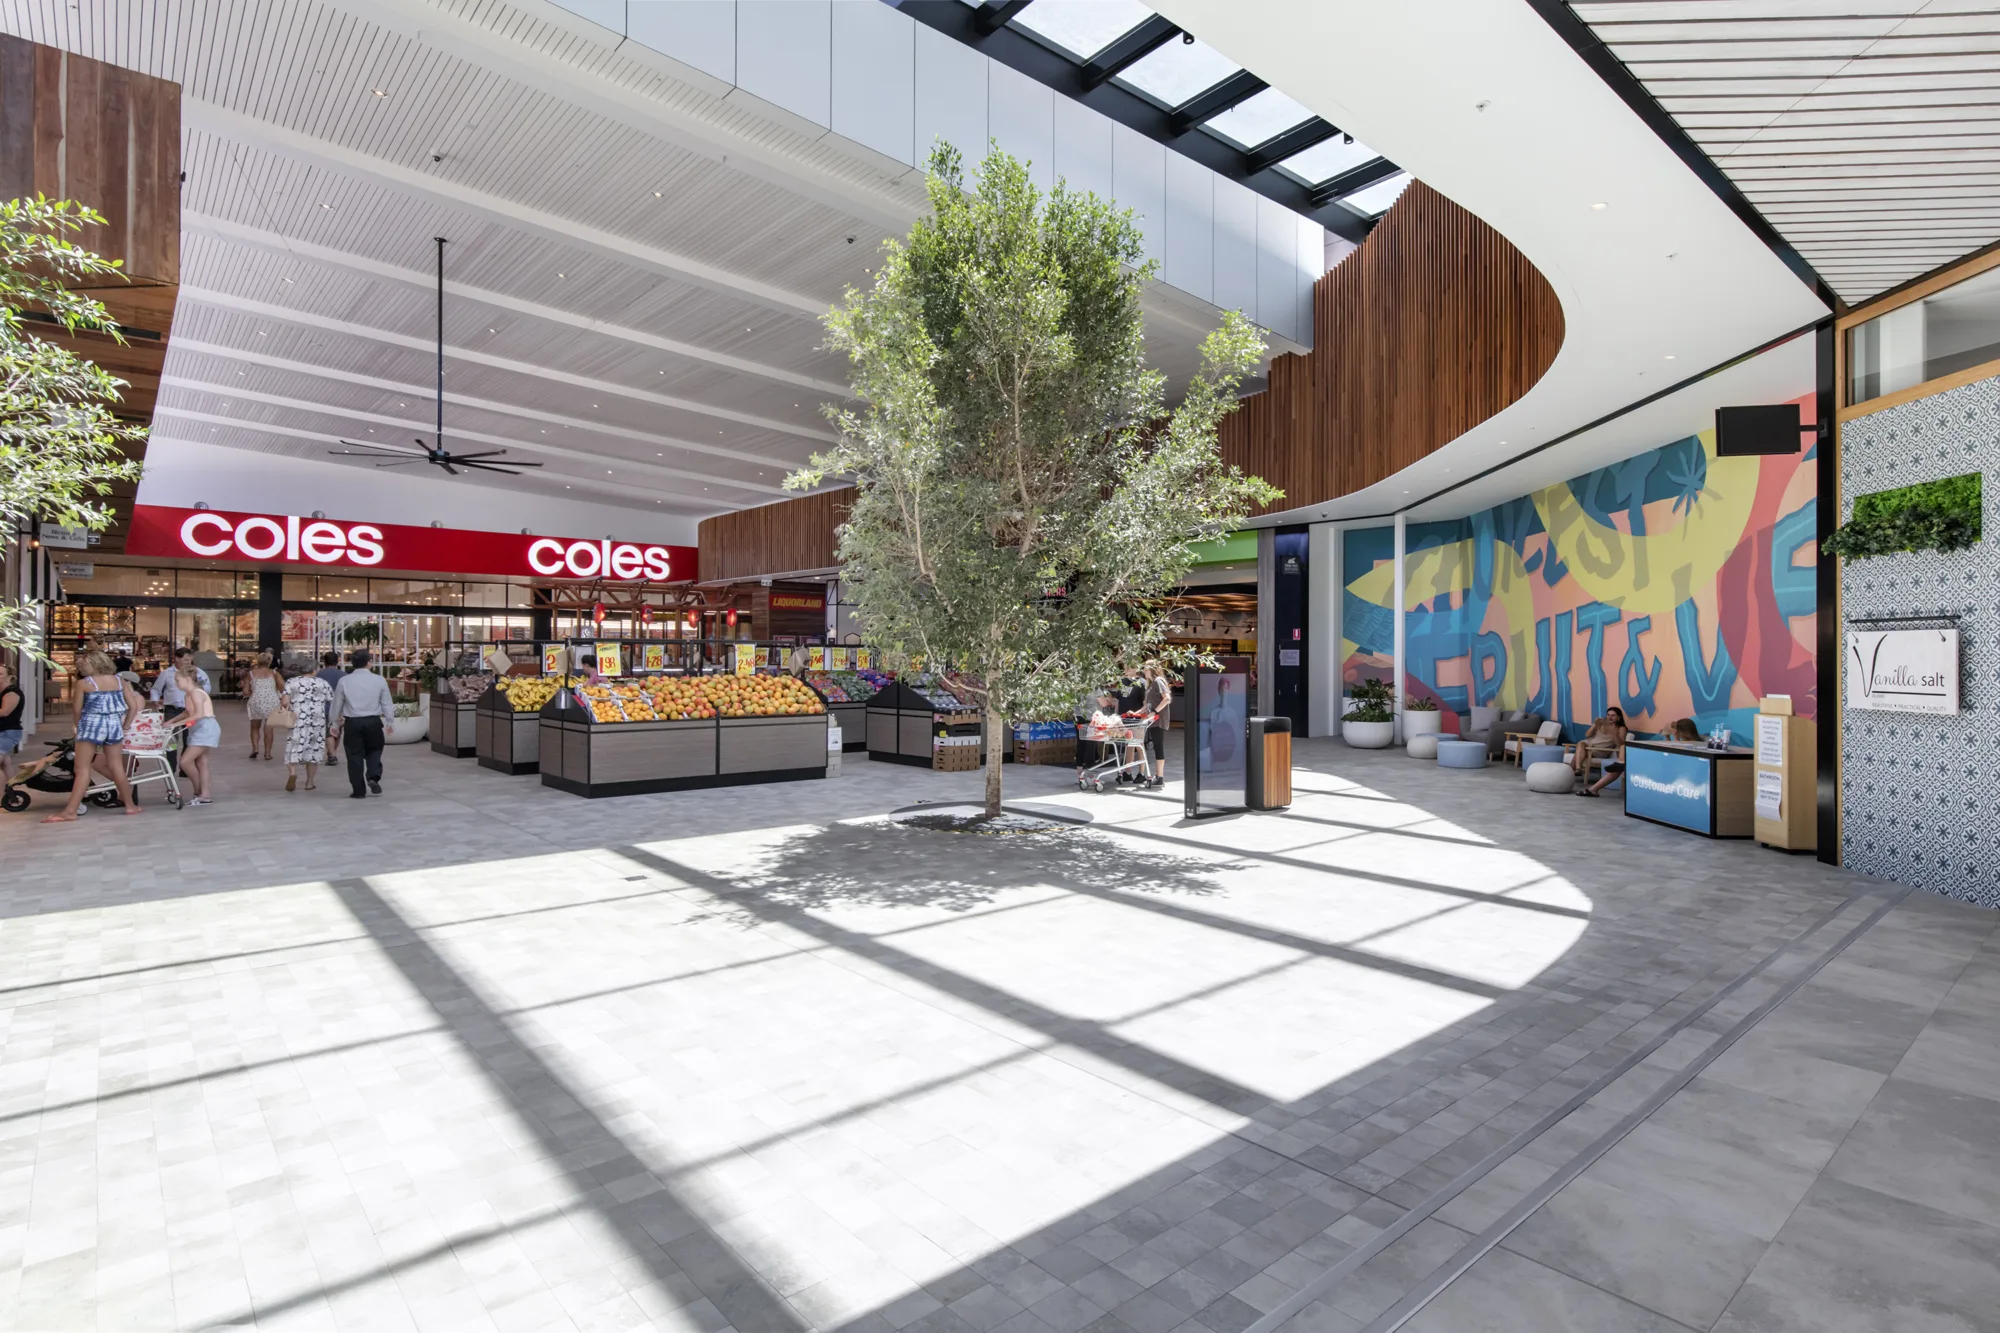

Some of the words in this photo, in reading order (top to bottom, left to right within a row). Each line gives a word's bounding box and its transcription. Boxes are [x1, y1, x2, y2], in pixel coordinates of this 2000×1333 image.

[180, 512, 385, 566] coles
[527, 538, 671, 581] coles
[772, 597, 822, 609] LIQUORLAND
[1852, 633, 1919, 698] Vanilla
[1921, 671, 1945, 688] salt
[1633, 775, 1675, 795] Customer
[1677, 784, 1700, 800] Care
